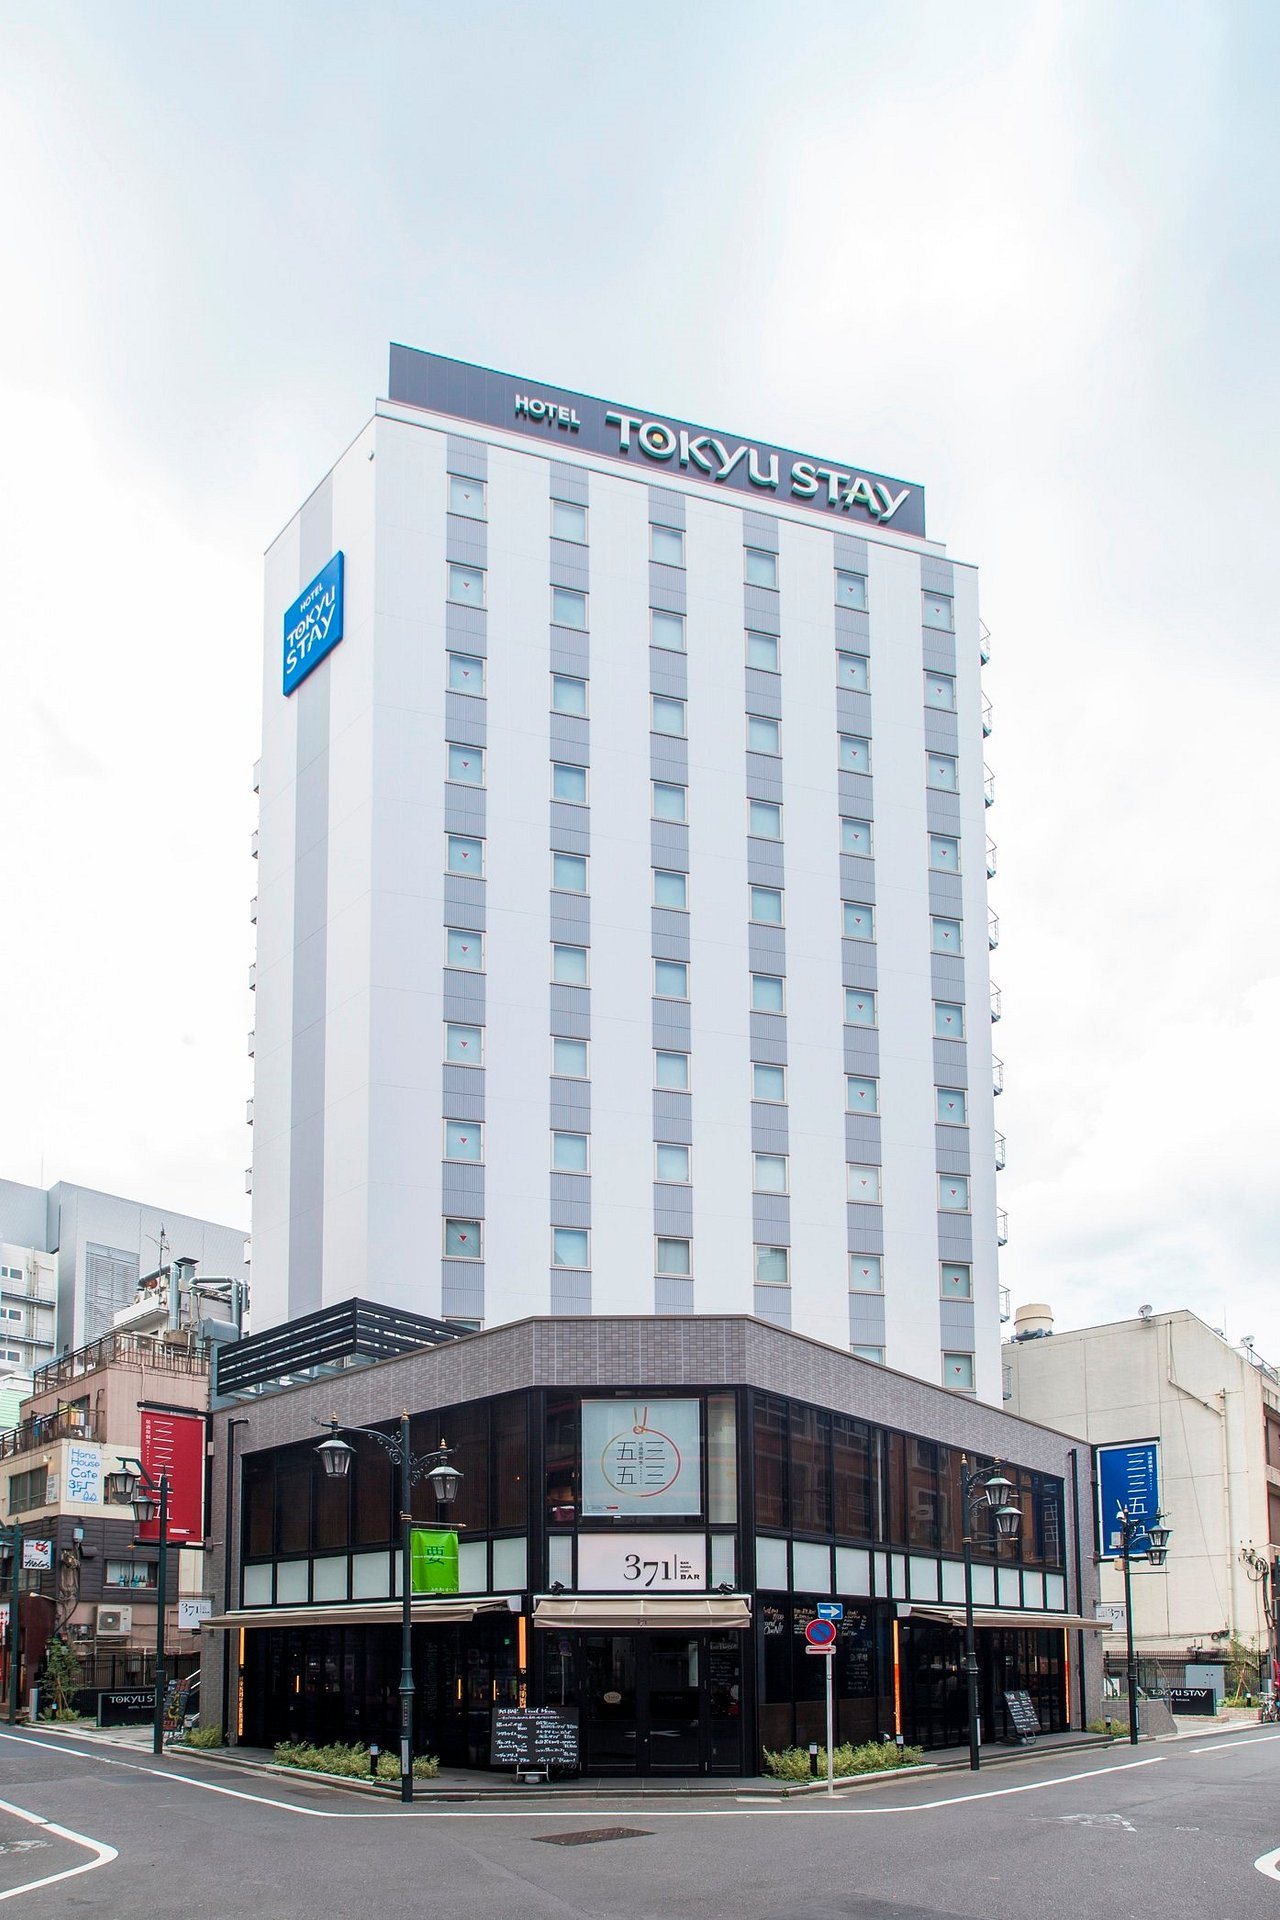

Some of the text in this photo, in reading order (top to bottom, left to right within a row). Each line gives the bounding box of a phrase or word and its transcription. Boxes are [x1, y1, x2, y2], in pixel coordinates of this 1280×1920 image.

[515, 394, 911, 522] HOTEL TOKYU STAY
[300, 582, 323, 613] HOTEL
[287, 585, 336, 648] TOKYU
[286, 603, 336, 674] STAY
[71, 1448, 96, 1459] Hana
[71, 1457, 100, 1467] House
[70, 1467, 97, 1479] Cafe
[68, 1479, 82, 1489] 3F
[623, 1554, 672, 1587] 371
[181, 1603, 199, 1616] 371
[109, 1695, 145, 1704] TOKYU
[1183, 1689, 1207, 1698] STAY
